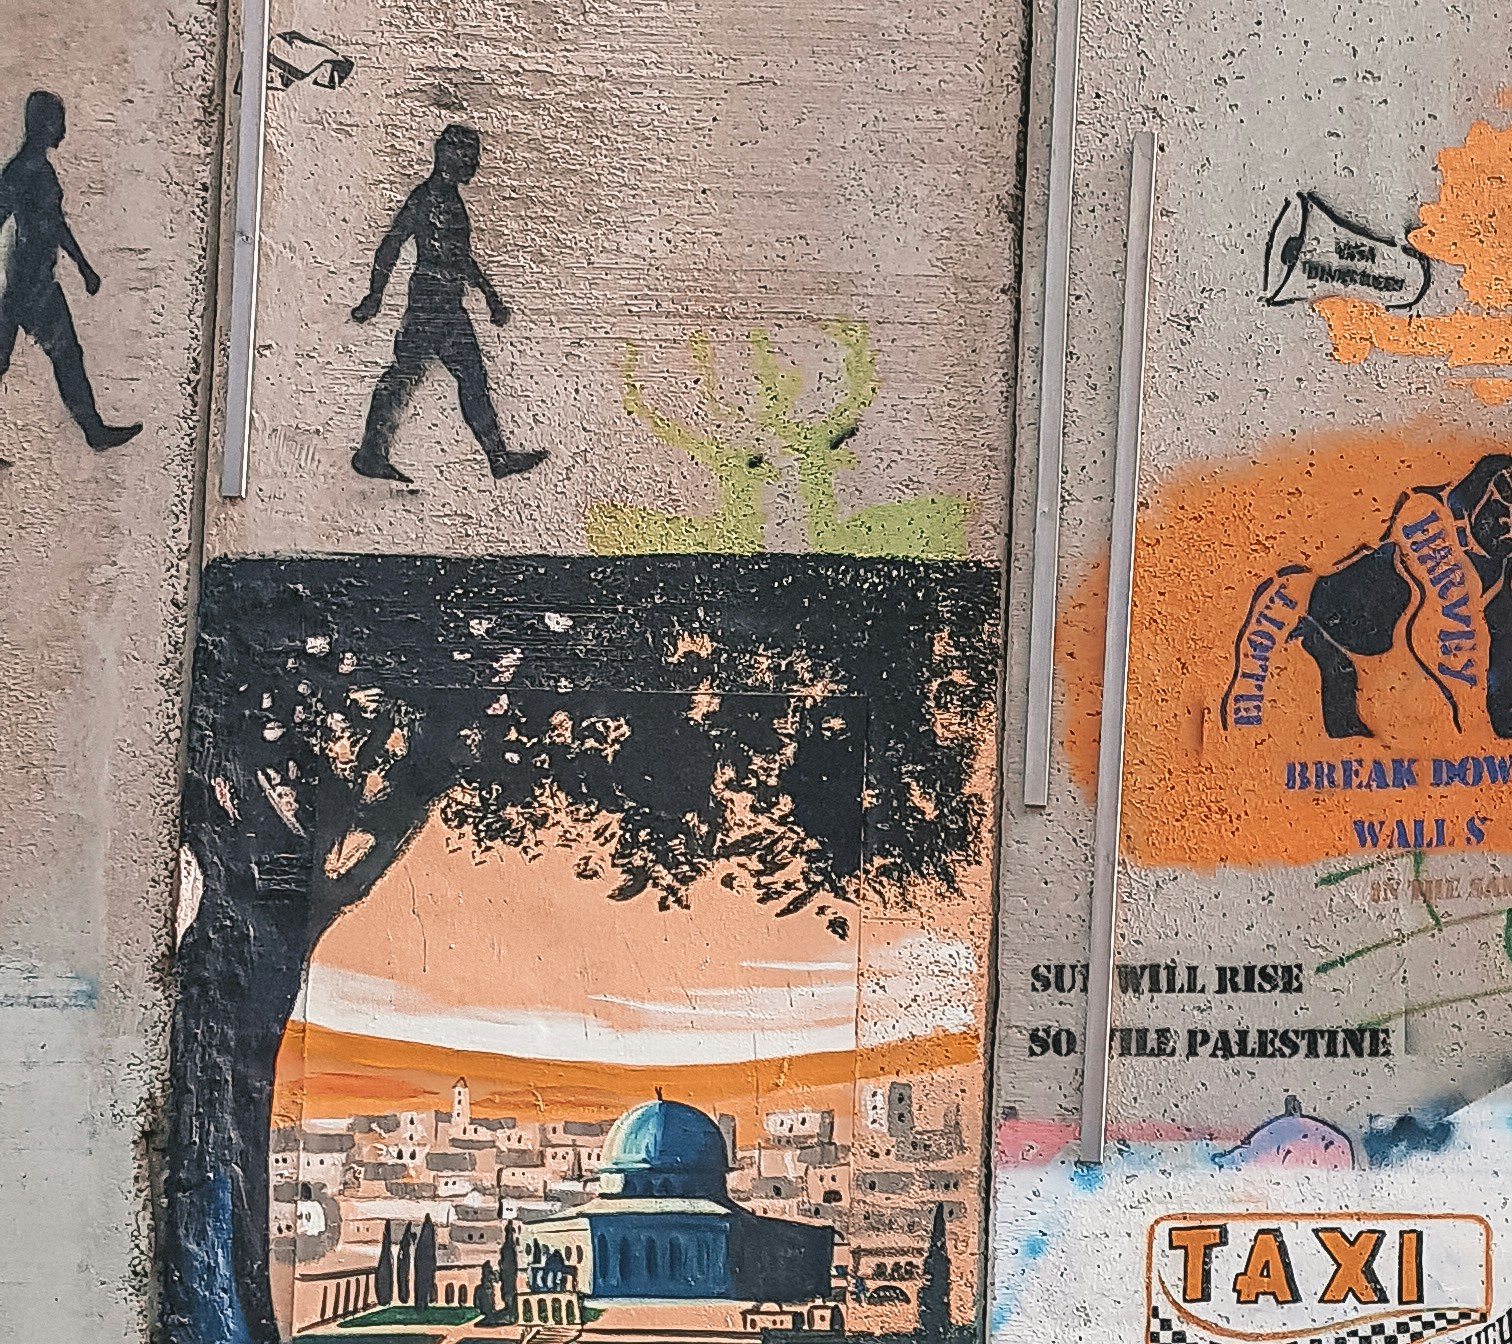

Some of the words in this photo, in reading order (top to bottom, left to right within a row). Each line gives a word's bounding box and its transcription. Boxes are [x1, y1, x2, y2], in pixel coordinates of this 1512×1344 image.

[1402, 509, 1478, 687] HARVEY
[1233, 582, 1299, 728] ELLIOTT
[1284, 757, 1418, 791] BREAK
[1214, 963, 1303, 994] RISE
[1027, 1029, 1077, 1058] SO
[1187, 1028, 1392, 1059] PALESTINE
[1168, 1224, 1427, 1306] TAXI
